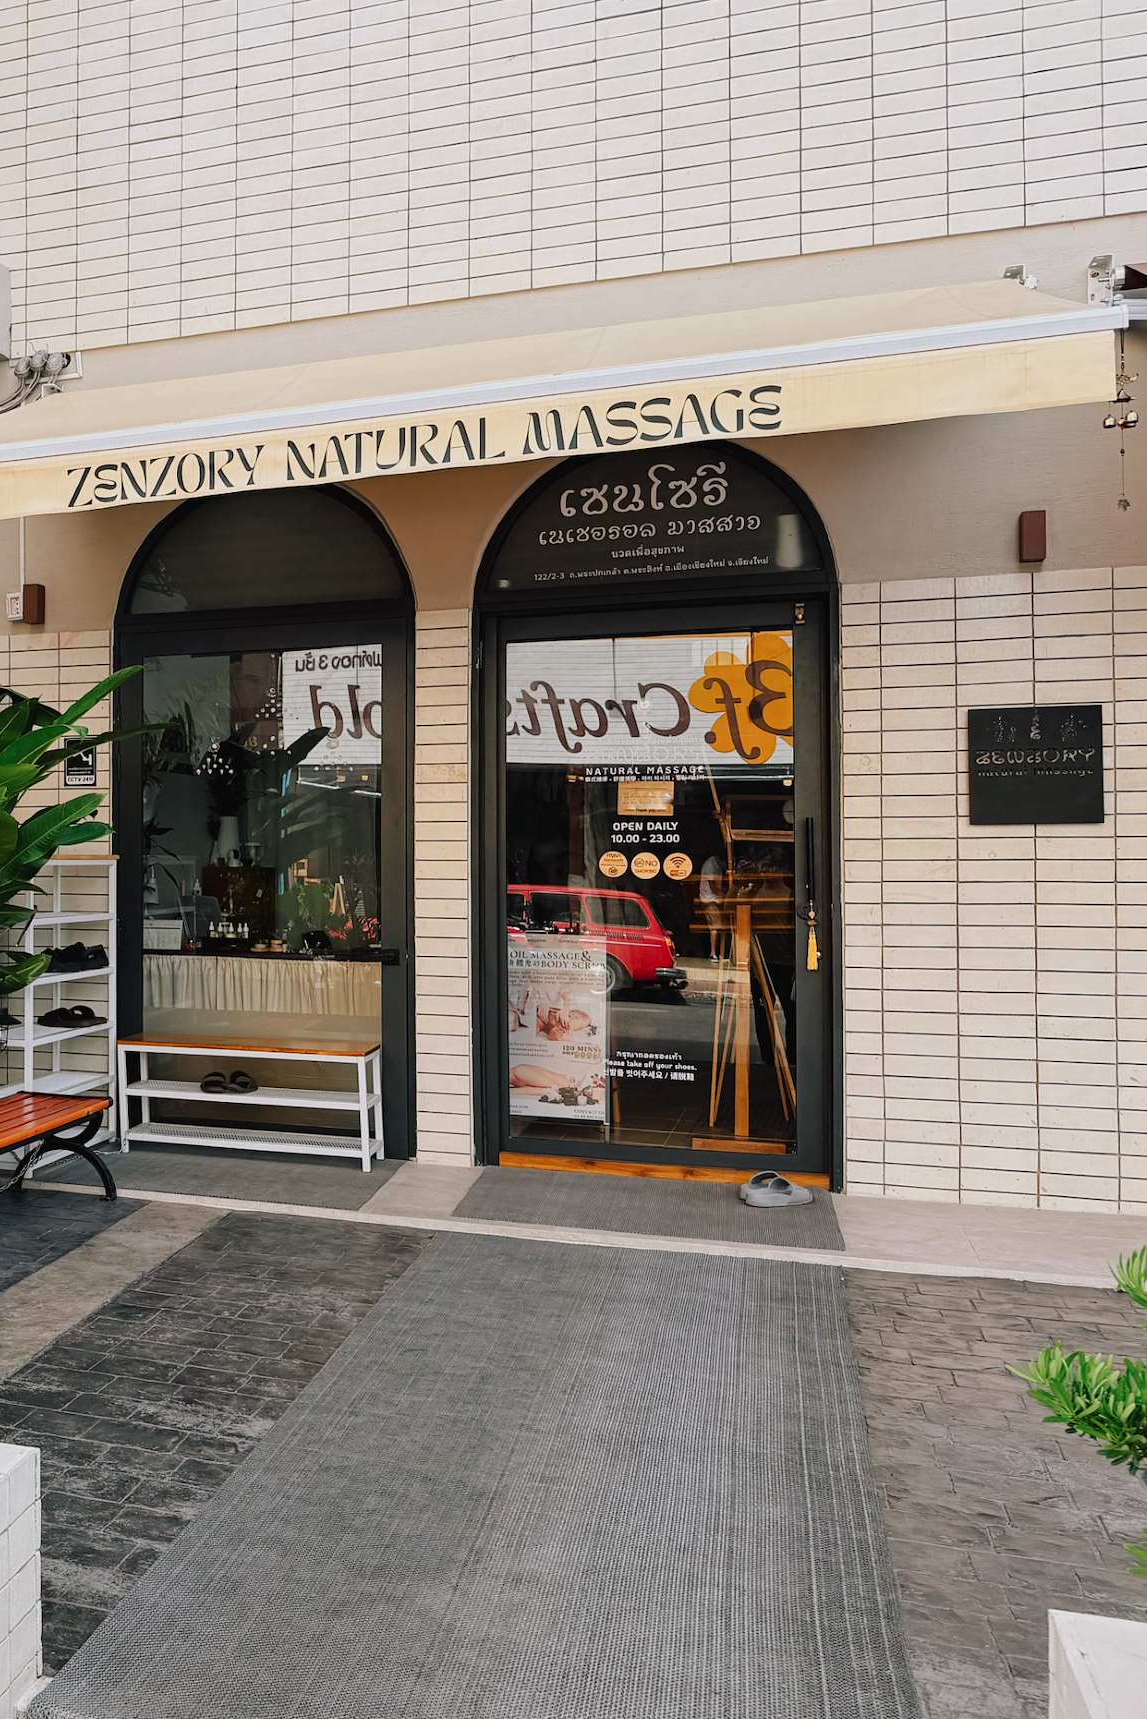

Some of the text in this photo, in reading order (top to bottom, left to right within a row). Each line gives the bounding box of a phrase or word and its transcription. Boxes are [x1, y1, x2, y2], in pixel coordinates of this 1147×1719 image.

[67, 385, 782, 508] ZENZORY NATURAL MASSAGE
[559, 461, 729, 518] เซนโซรี
[538, 522, 656, 546] เนเชอรอล
[585, 765, 705, 776] NATURAL MASSAGE
[612, 821, 679, 831] OPEN DAILY
[610, 834, 640, 843] 10.00
[649, 834, 680, 843] 23.00
[509, 950, 528, 959] OIL
[540, 960, 570, 969] BODY
[626, 1060, 642, 1068] take
[655, 1063, 673, 1072] your
[674, 1063, 697, 1071] shoes.
